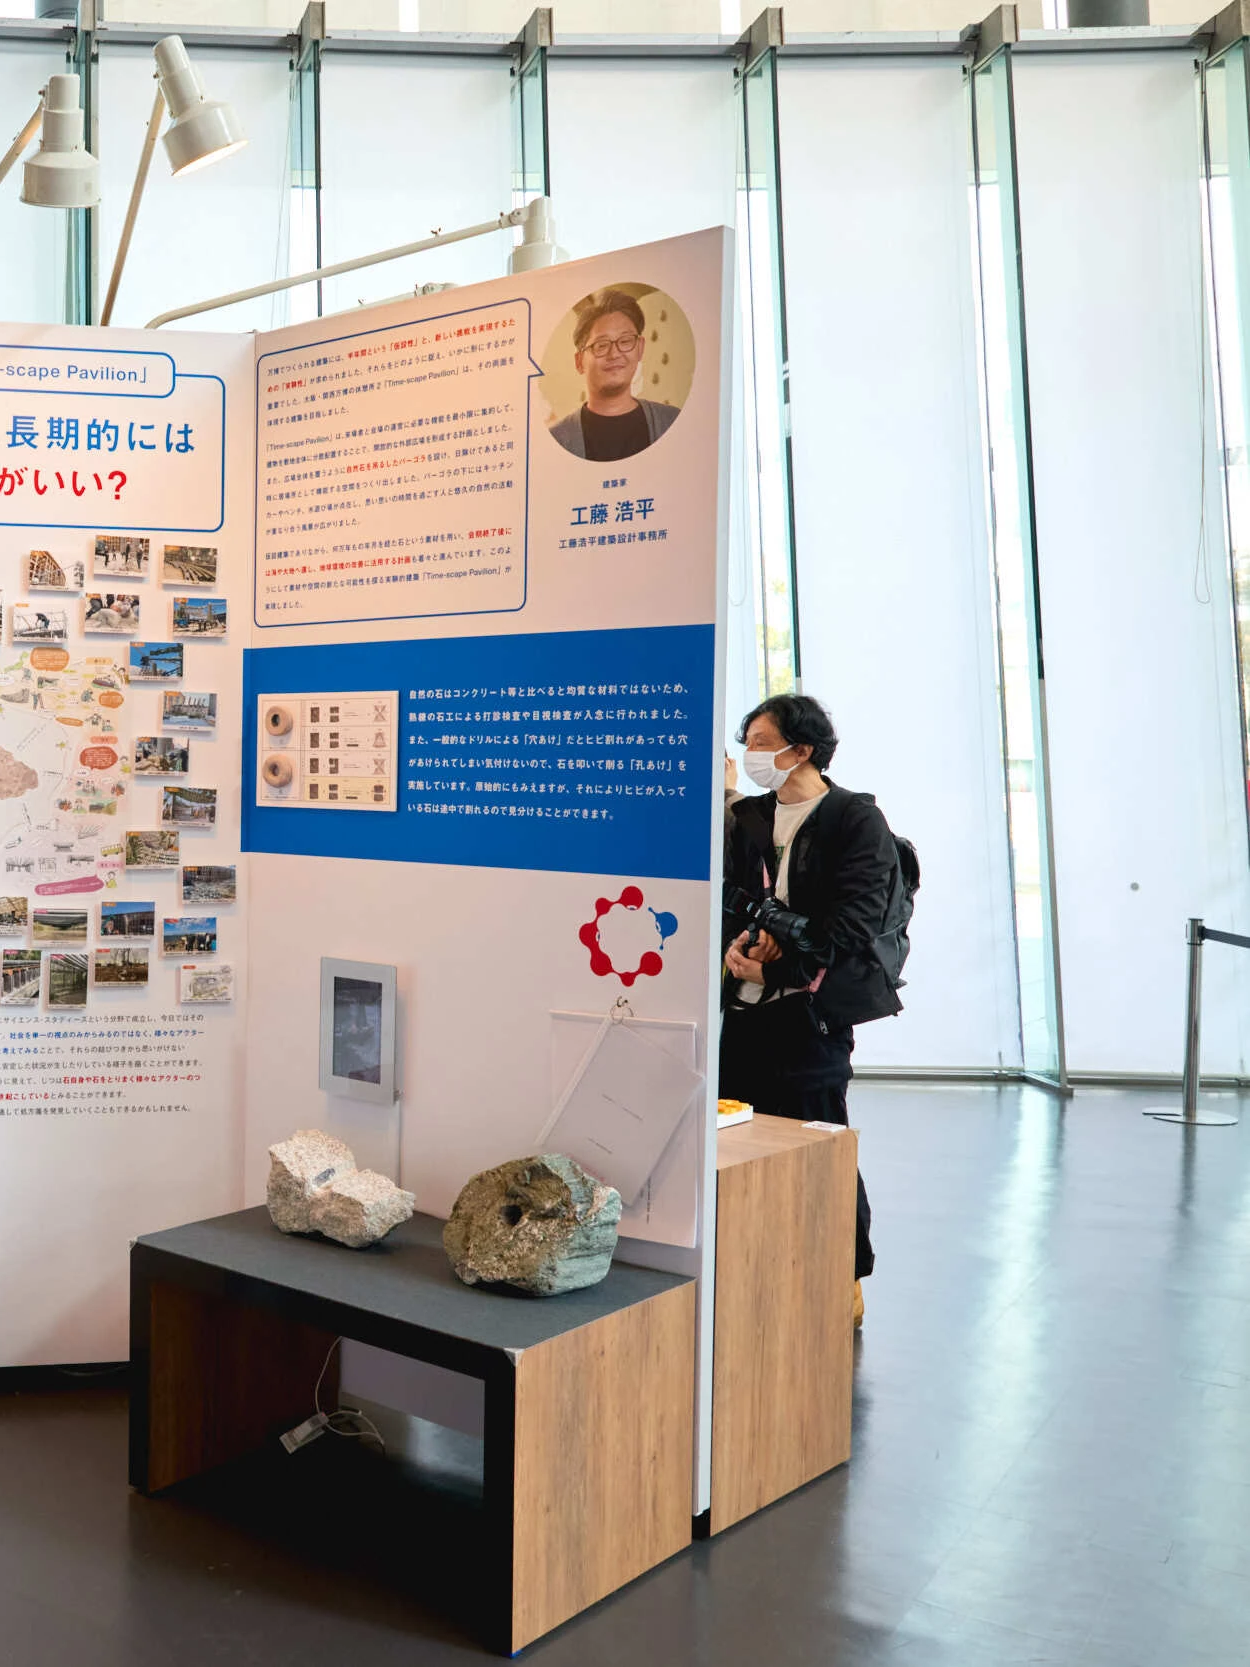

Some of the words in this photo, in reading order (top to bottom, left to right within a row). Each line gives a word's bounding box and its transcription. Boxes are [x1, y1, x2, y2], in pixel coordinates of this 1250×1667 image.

[67, 365, 148, 385] Pavilion」
[602, 478, 627, 489] 建築家
[570, 504, 608, 526] 工藤
[614, 498, 655, 522] 浩平
[558, 529, 668, 549] 工藤浩平建築設計事務所
